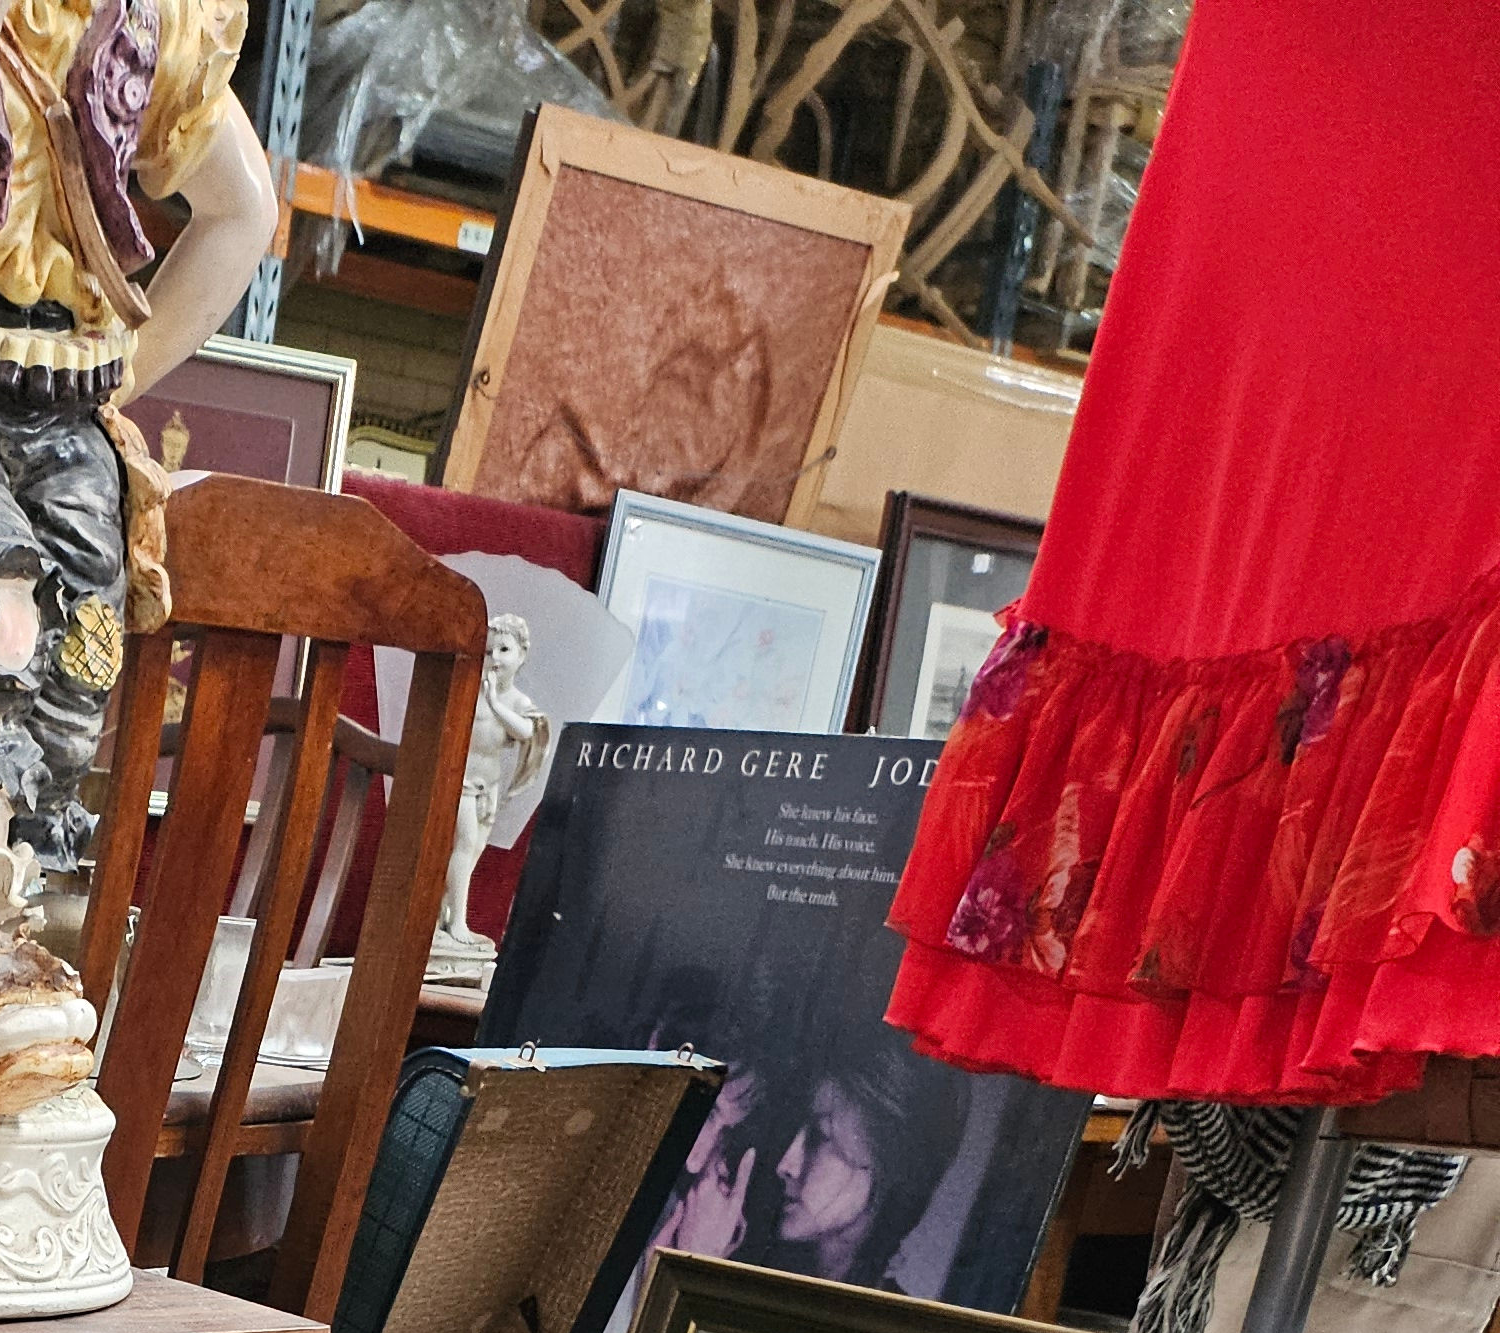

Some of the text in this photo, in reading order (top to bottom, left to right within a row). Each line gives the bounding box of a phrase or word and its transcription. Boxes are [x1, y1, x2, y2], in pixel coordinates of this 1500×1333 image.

[576, 741, 830, 780] RICHARD GERE
[778, 803, 800, 820] She
[800, 805, 833, 822] knew
[833, 806, 851, 824] his
[764, 828, 785, 846] His
[821, 832, 844, 850] His
[725, 853, 745, 870] She
[745, 855, 775, 873] knew
[776, 859, 837, 880] everything
[836, 864, 871, 881] about
[766, 884, 788, 901] But
[788, 887, 808, 903] the
